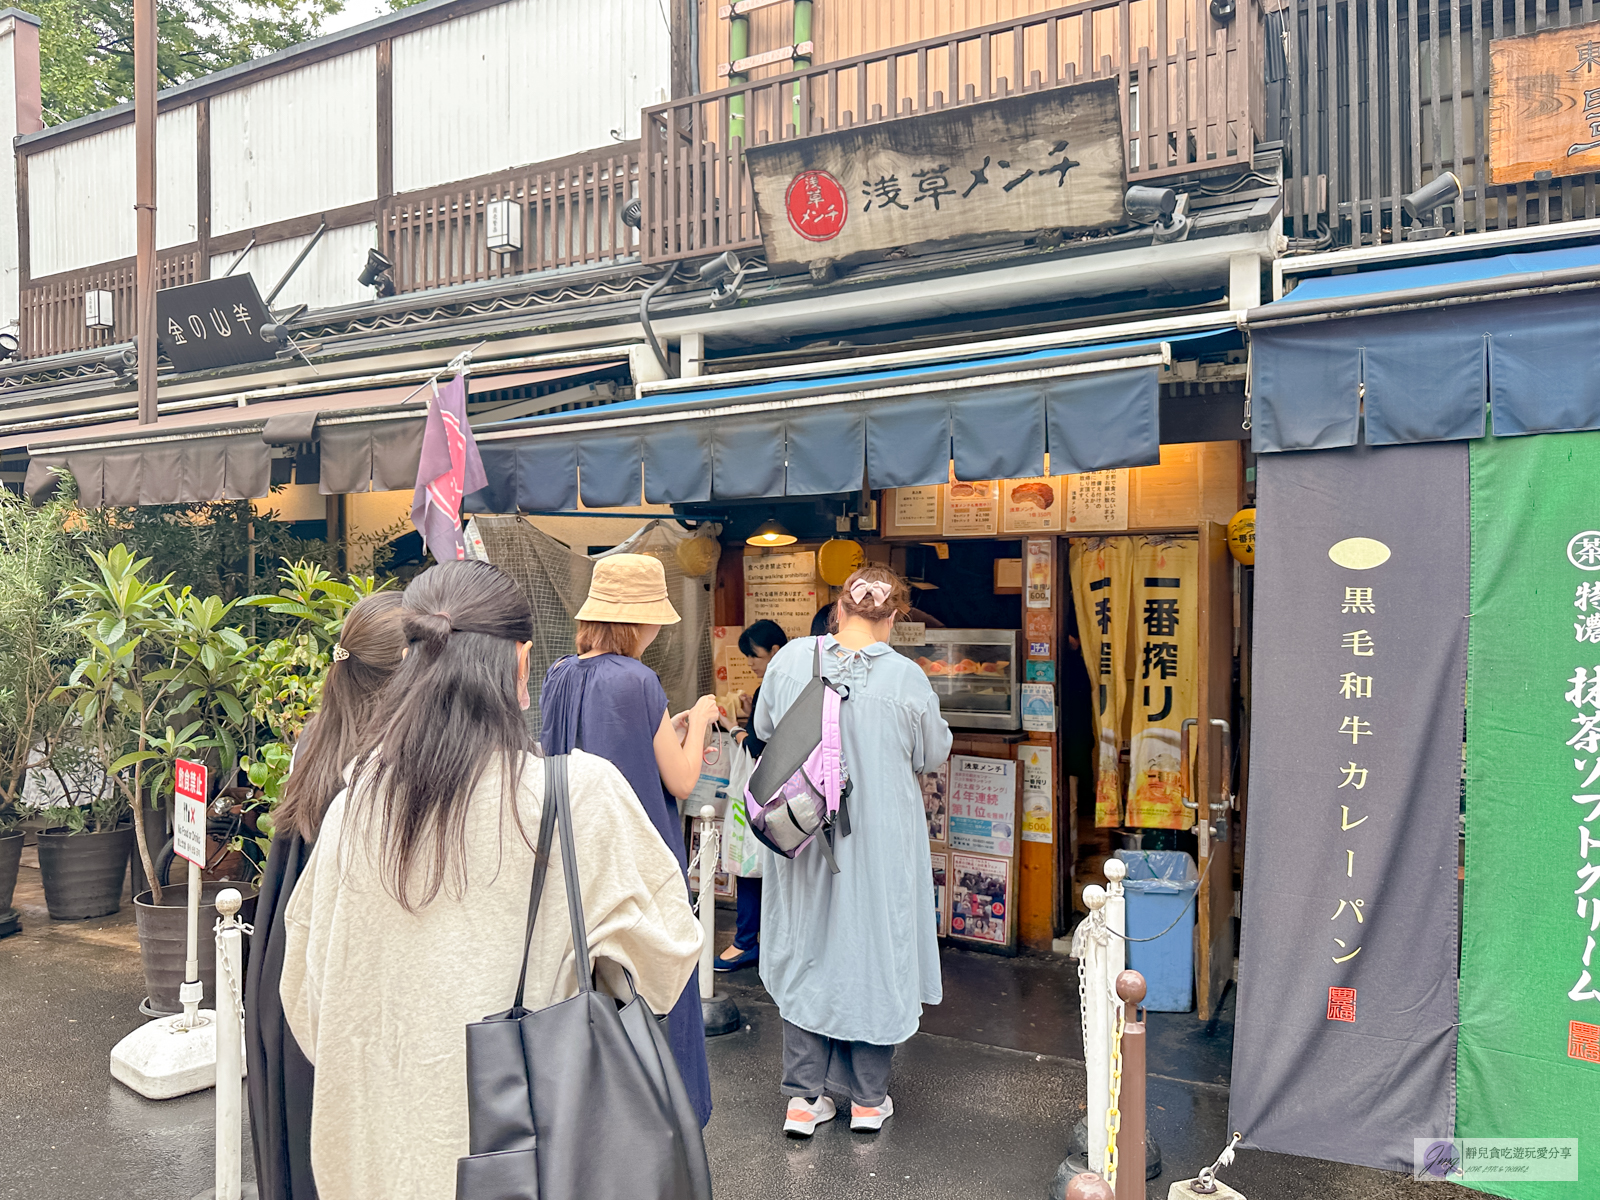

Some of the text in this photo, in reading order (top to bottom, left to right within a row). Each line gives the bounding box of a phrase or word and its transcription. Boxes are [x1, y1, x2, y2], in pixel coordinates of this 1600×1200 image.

[805, 176, 825, 208] 浅草
[862, 140, 1080, 212] 浅草メンチ
[801, 204, 839, 224] メンチ
[168, 303, 252, 345] 金の山羊
[1142, 577, 1181, 722] 一番搾り
[178, 766, 203, 796] 飲食禁止
[964, 763, 1002, 772] 浅草メンチ
[1331, 585, 1376, 965] 黒毛和牛カレーパン
[952, 789, 999, 806] 4年連続
